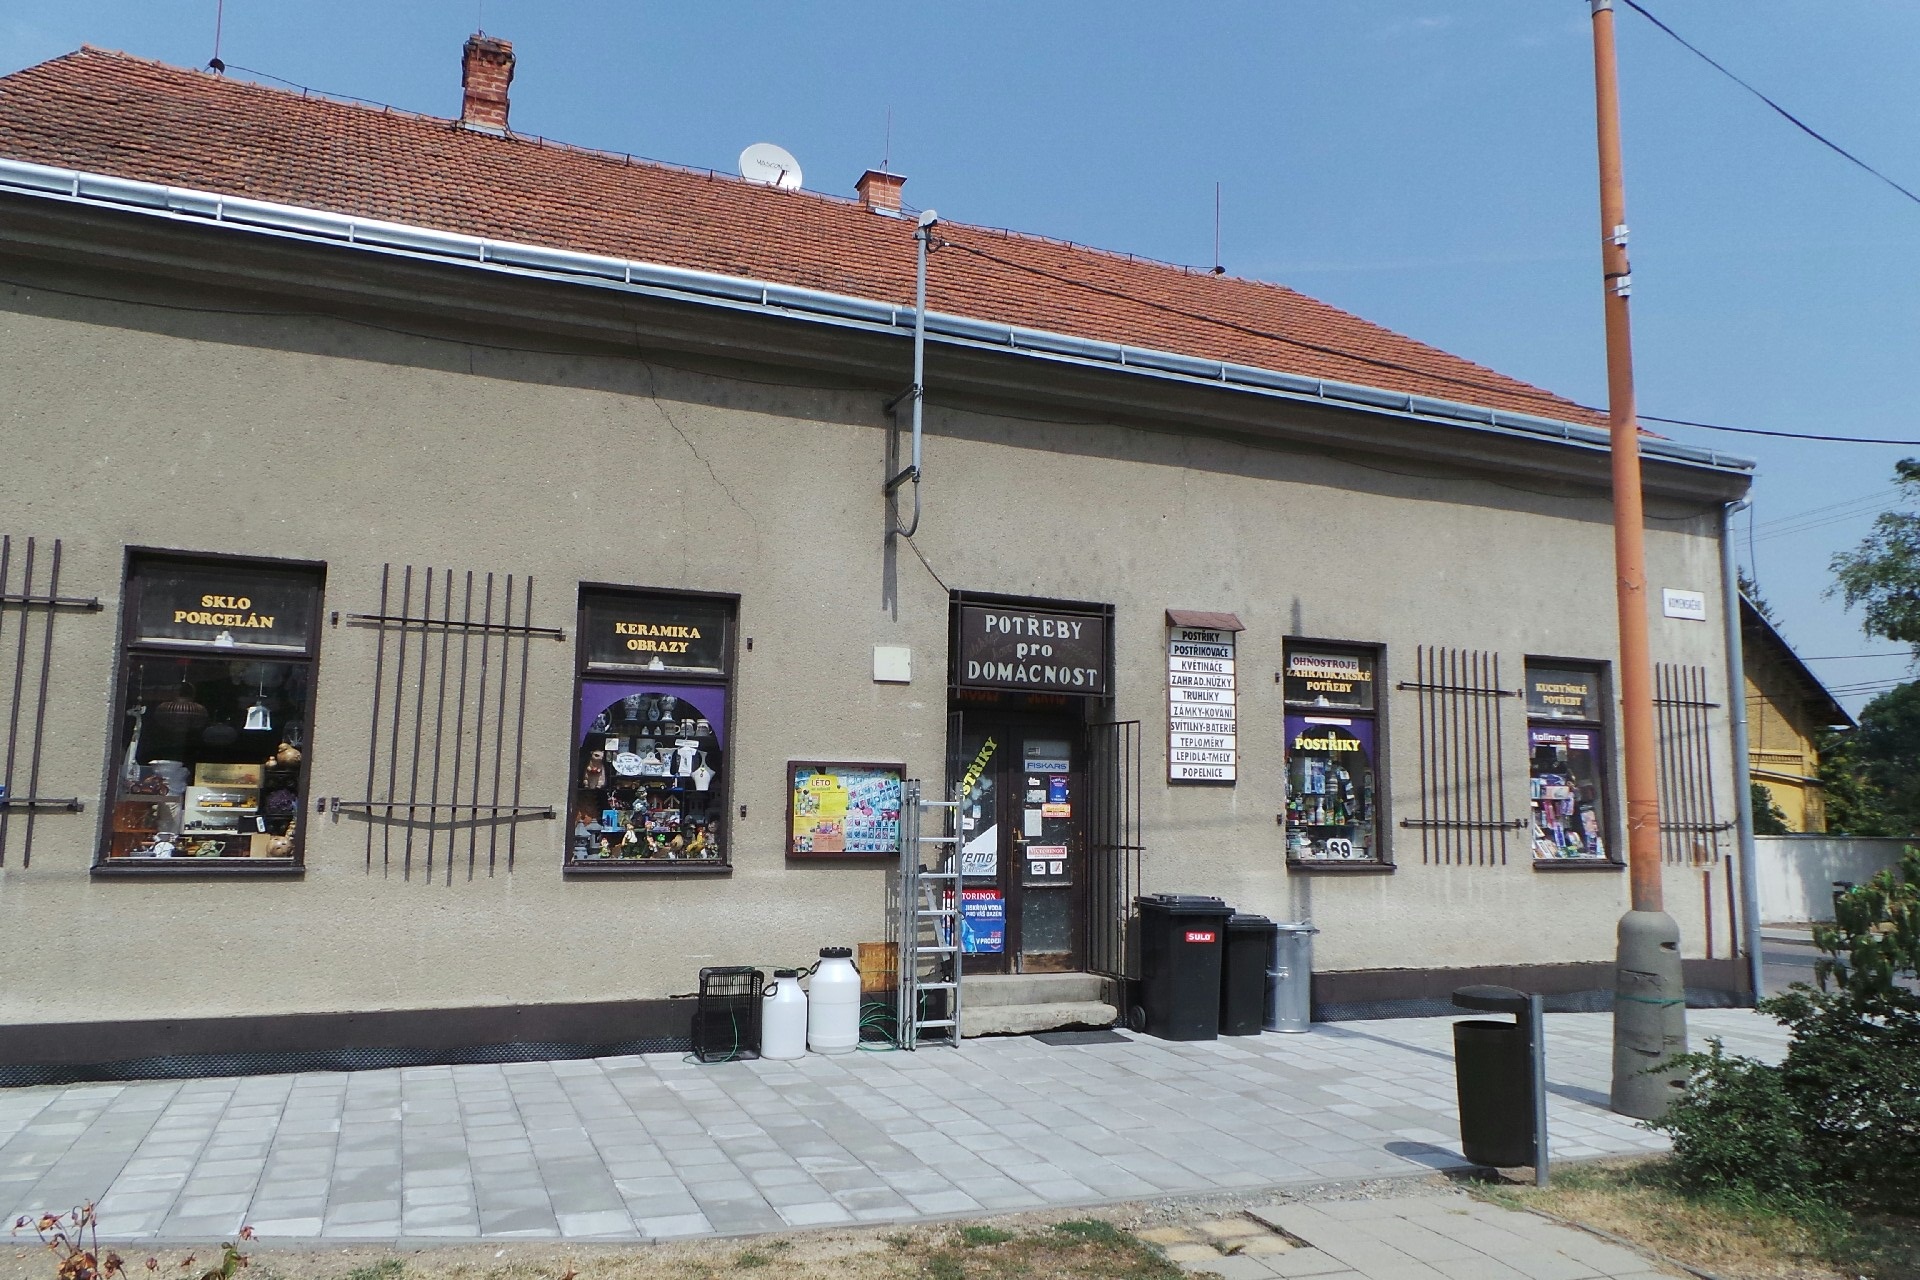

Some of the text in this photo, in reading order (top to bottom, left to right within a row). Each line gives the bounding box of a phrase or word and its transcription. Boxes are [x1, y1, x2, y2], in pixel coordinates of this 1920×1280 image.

[201, 595, 251, 609] SKLO
[174, 611, 274, 628] PORCELÁN
[615, 622, 701, 638] KERAMIKA
[985, 614, 1082, 640] POTŘEBY
[1182, 630, 1220, 643] POSTŘIKY
[627, 639, 689, 653] OBRAZY
[1016, 642, 1053, 659] pro
[1174, 644, 1228, 658] POSTŘIKOVAČE
[1181, 659, 1223, 672] KVĚTINÁČE
[1292, 656, 1357, 670] OHŇOSTROJE
[968, 659, 1098, 687] DOMÁCNOST
[1306, 680, 1352, 693] POTŘEBY
[1536, 684, 1587, 694] KUCHYŇSKÉ
[1182, 689, 1220, 702] TRUHLÍKY
[1543, 695, 1581, 705] POTŘEBY
[1173, 704, 1233, 718] ZÁMKY-KOVÁNÍ
[1170, 720, 1235, 733] SVÍTILNY-BATERIE
[1180, 736, 1224, 748] TEPLOMĚRY
[1295, 734, 1361, 752] POSTŘIKY
[1176, 751, 1231, 763] LEPIDLA-TMELY
[1027, 762, 1067, 770] FISKARS
[1182, 767, 1223, 778] POPELNICE
[811, 777, 831, 787] LÉTO
[1188, 933, 1211, 941] SULO
